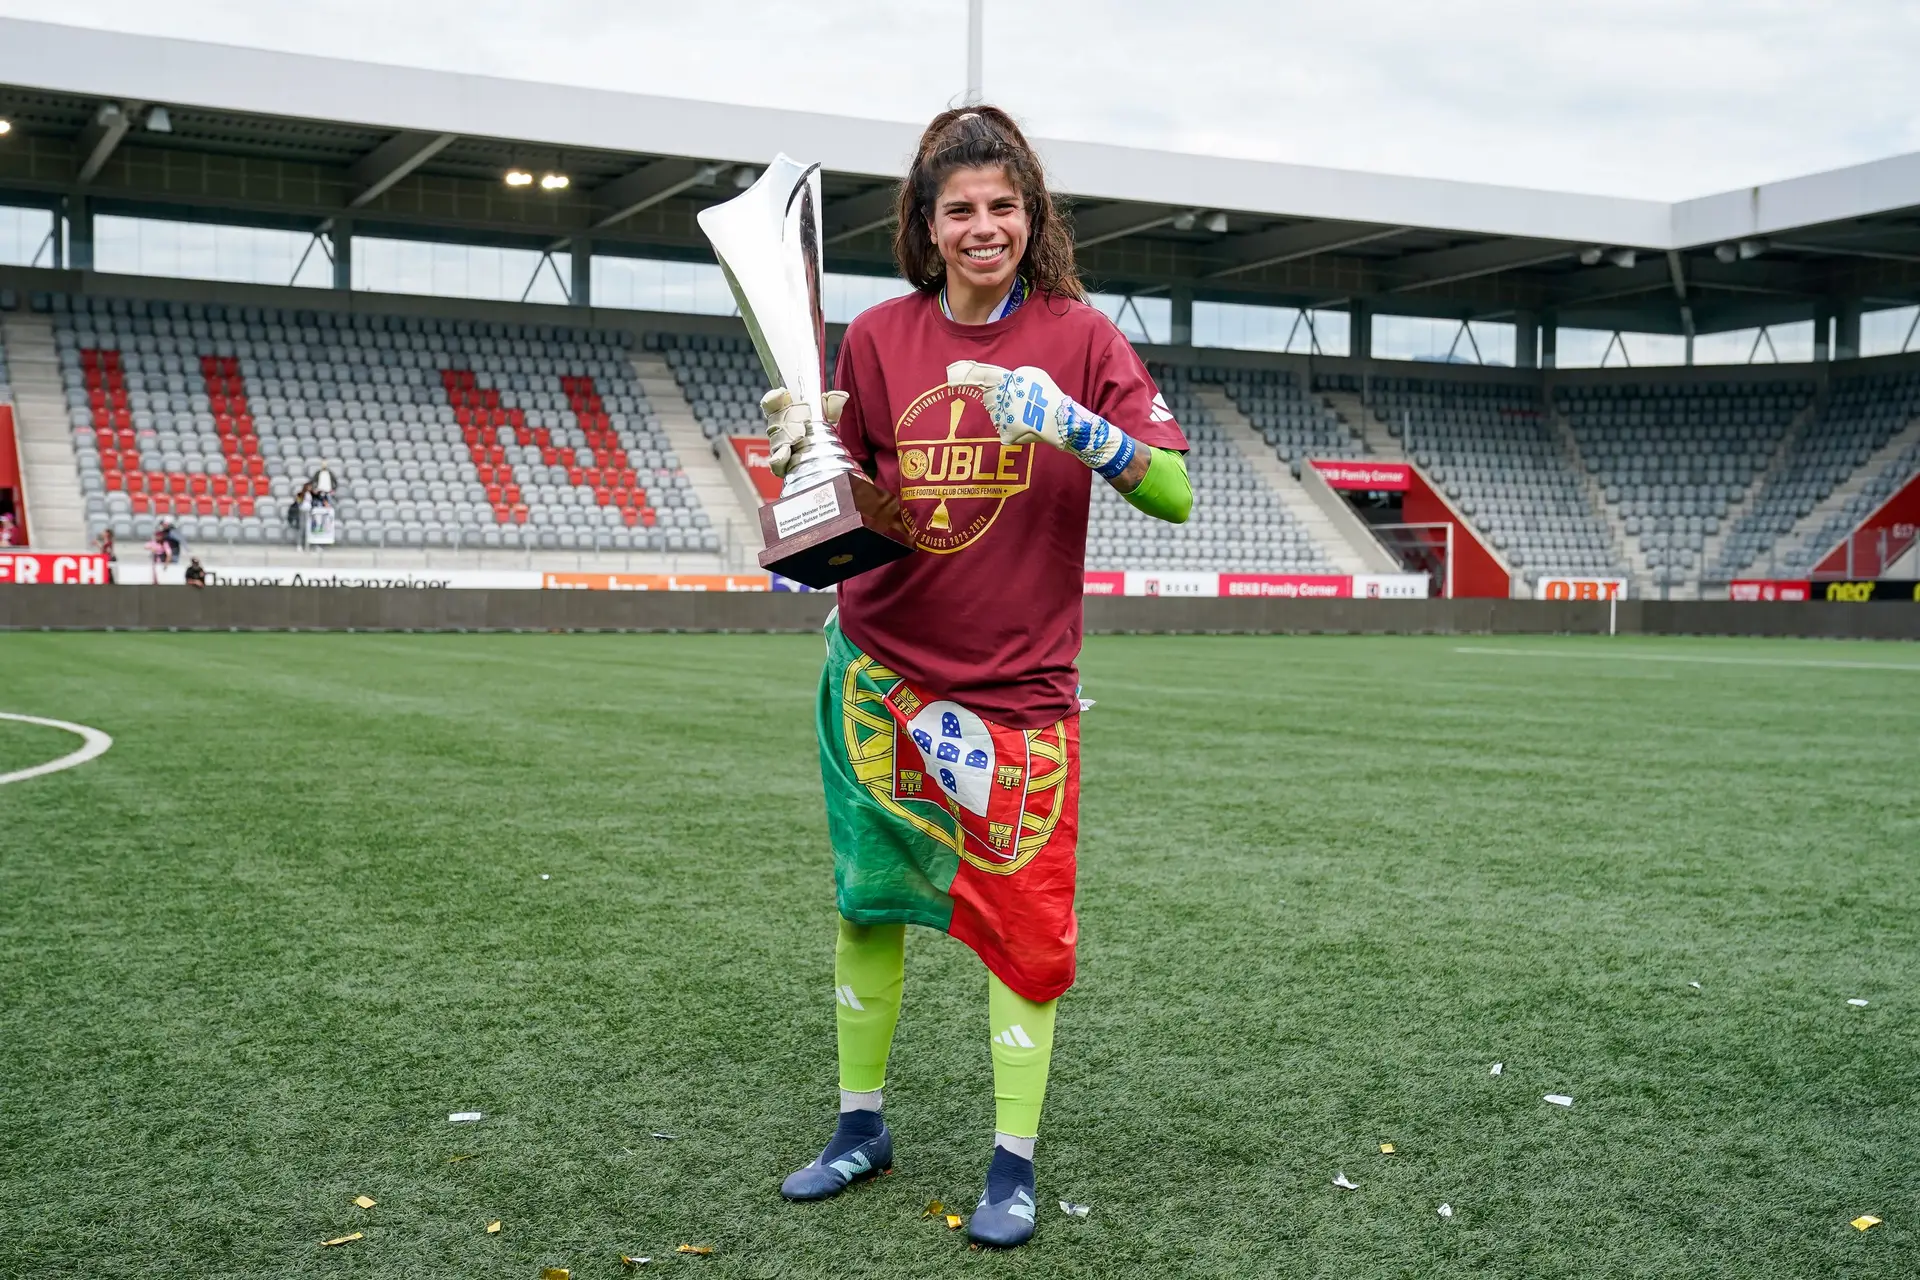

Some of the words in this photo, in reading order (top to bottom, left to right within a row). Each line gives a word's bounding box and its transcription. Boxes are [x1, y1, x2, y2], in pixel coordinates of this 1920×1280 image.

[916, 488, 941, 497] FOOTBALL
[942, 488, 956, 496] CLUB
[957, 487, 980, 496] CHENOIS
[981, 486, 1003, 495] FEMININ
[779, 515, 802, 527] Schweizer
[801, 507, 819, 518] Meister
[819, 500, 835, 511] Frauen
[780, 521, 803, 534] Champion
[803, 514, 819, 525] Suisse
[818, 507, 837, 518] femmes
[1084, 581, 1115, 595] orner
[1298, 583, 1339, 597] Corner
